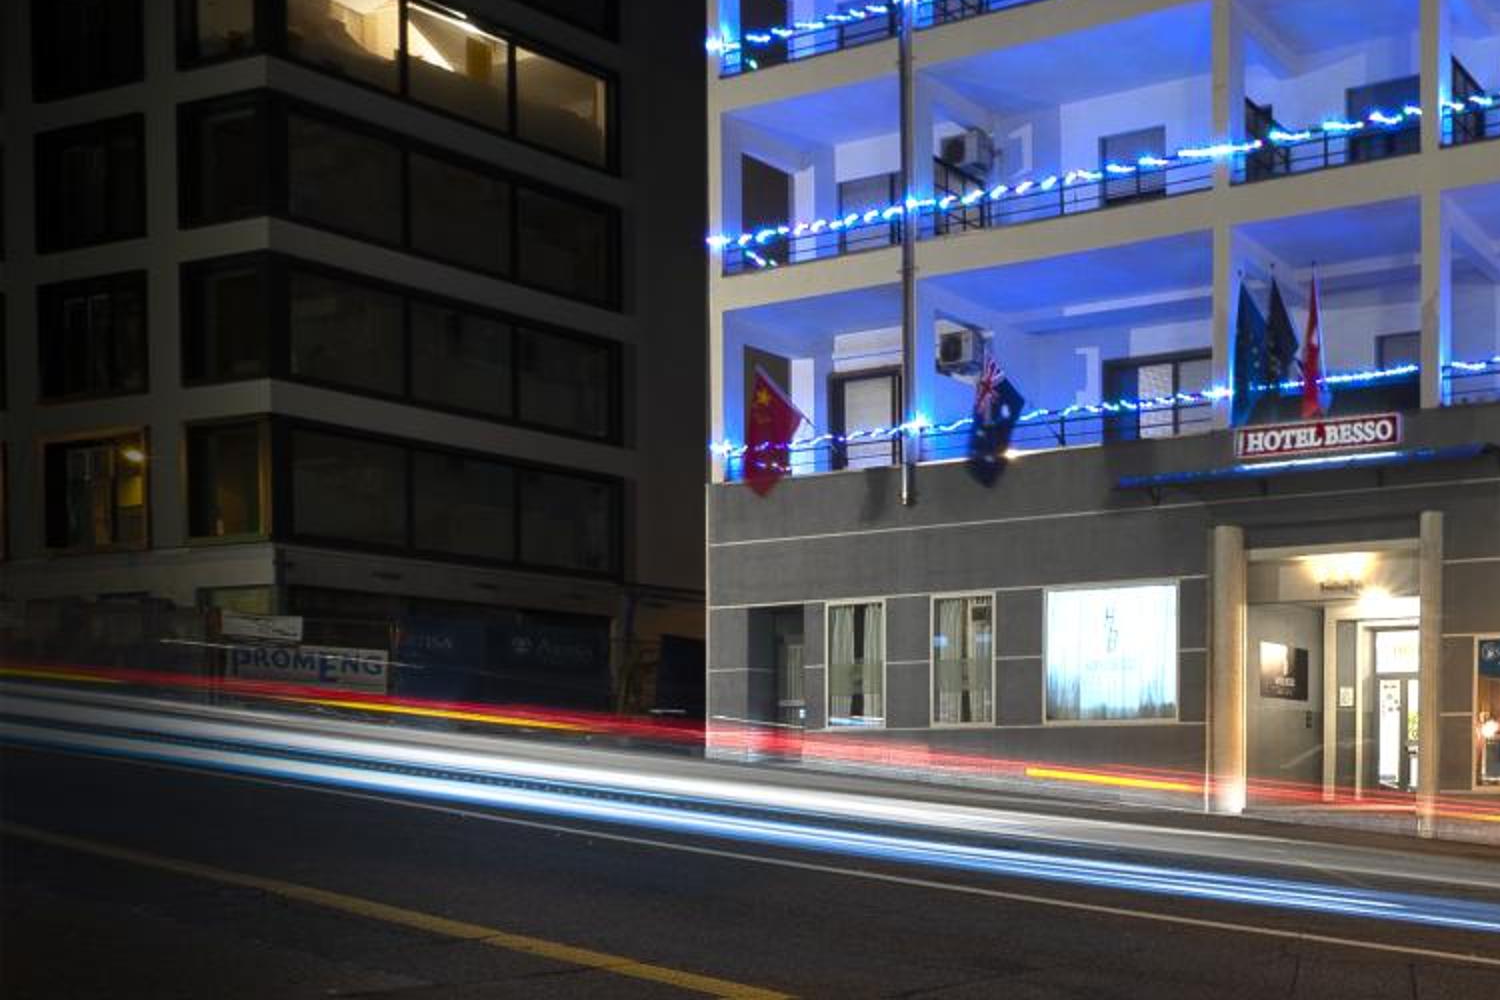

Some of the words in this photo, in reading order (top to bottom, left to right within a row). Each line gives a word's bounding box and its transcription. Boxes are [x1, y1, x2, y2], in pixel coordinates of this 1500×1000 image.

[1247, 427, 1322, 452] HOTEL
[1324, 420, 1393, 445] BESSO
[232, 646, 383, 682] PROMENG
